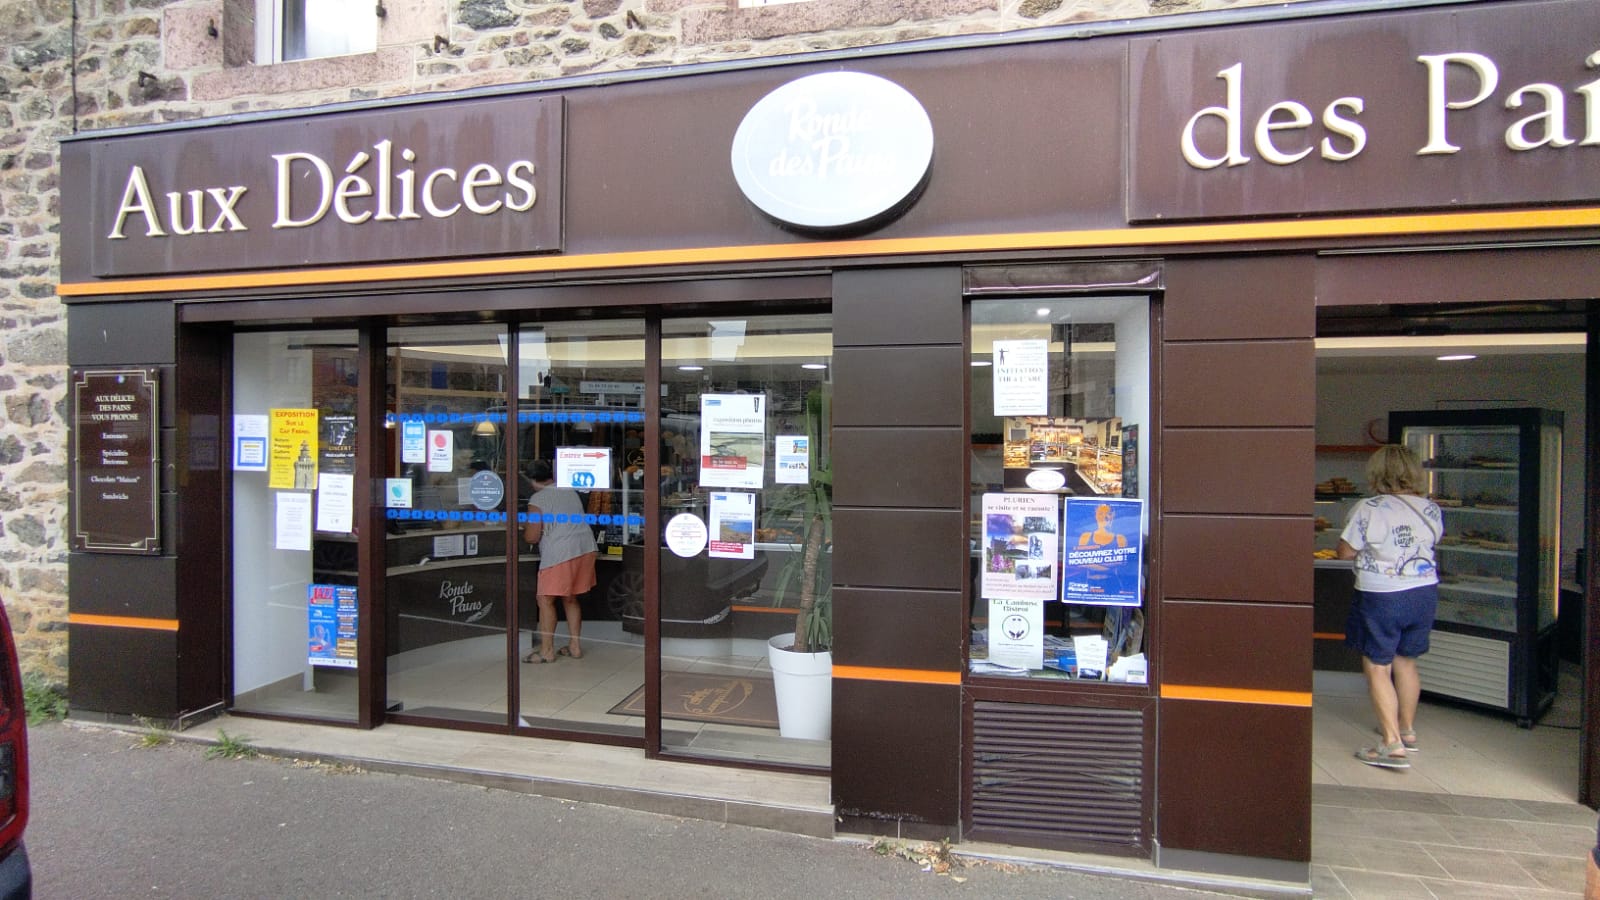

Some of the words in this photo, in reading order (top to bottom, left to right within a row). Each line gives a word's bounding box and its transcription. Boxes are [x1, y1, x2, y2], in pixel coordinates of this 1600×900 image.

[785, 98, 874, 142] Ronde
[1180, 62, 1367, 169] des
[768, 145, 815, 178] des
[108, 165, 248, 240] Aux
[272, 138, 537, 230] Délices
[110, 393, 135, 402] DÉLICES
[91, 413, 110, 421] VOUS
[111, 413, 139, 421] PROPOSE
[99, 404, 111, 412] DES
[112, 404, 132, 412] PAINS
[102, 449, 129, 457] Spécialités
[1068, 549, 1113, 559] DÉCOUVREZ
[1113, 547, 1137, 555] VOTRE
[1068, 556, 1104, 566] NOUVEAU
[1103, 555, 1124, 563] CLUB
[311, 585, 334, 605] JAZZ
[439, 580, 474, 599] Ronde
[449, 595, 482, 616] Pains
